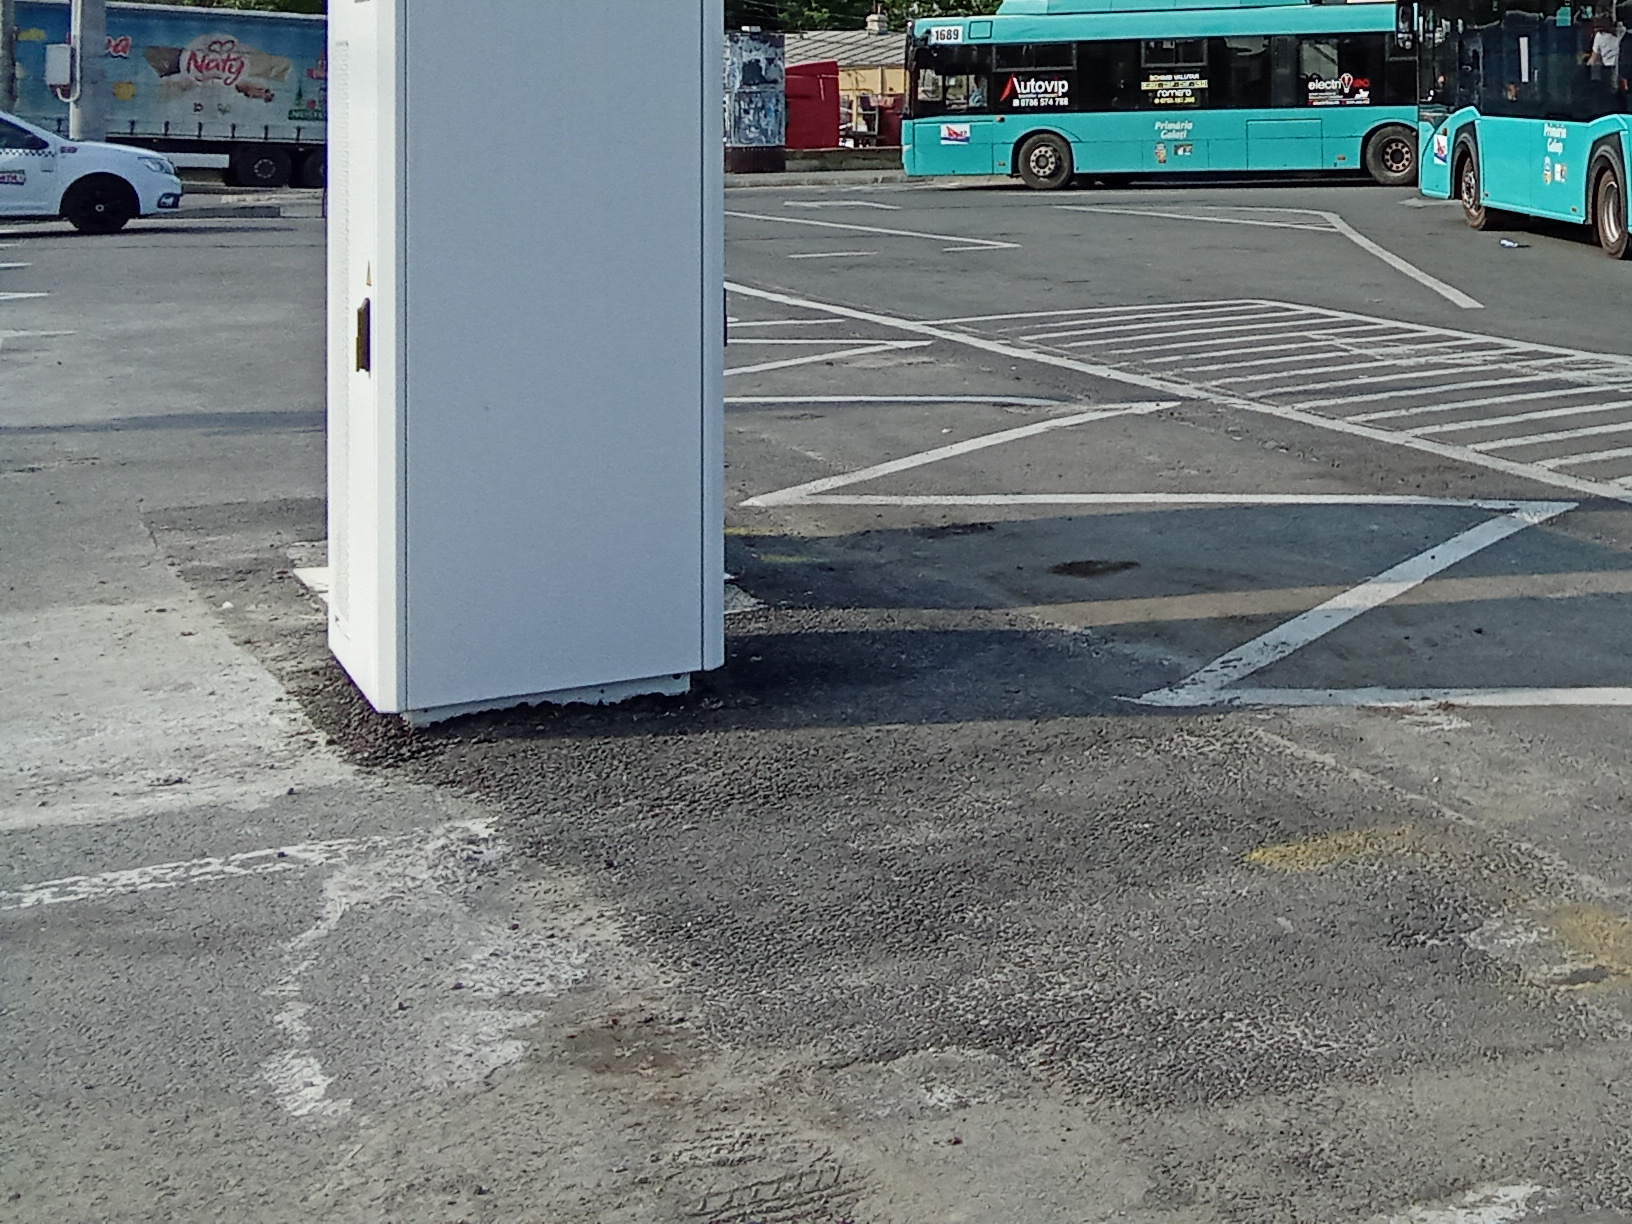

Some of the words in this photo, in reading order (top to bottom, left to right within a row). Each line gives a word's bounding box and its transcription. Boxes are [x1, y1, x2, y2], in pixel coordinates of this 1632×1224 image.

[935, 29, 959, 41] 1689
[187, 50, 247, 86] Naty
[1000, 73, 1069, 102] Autovip
